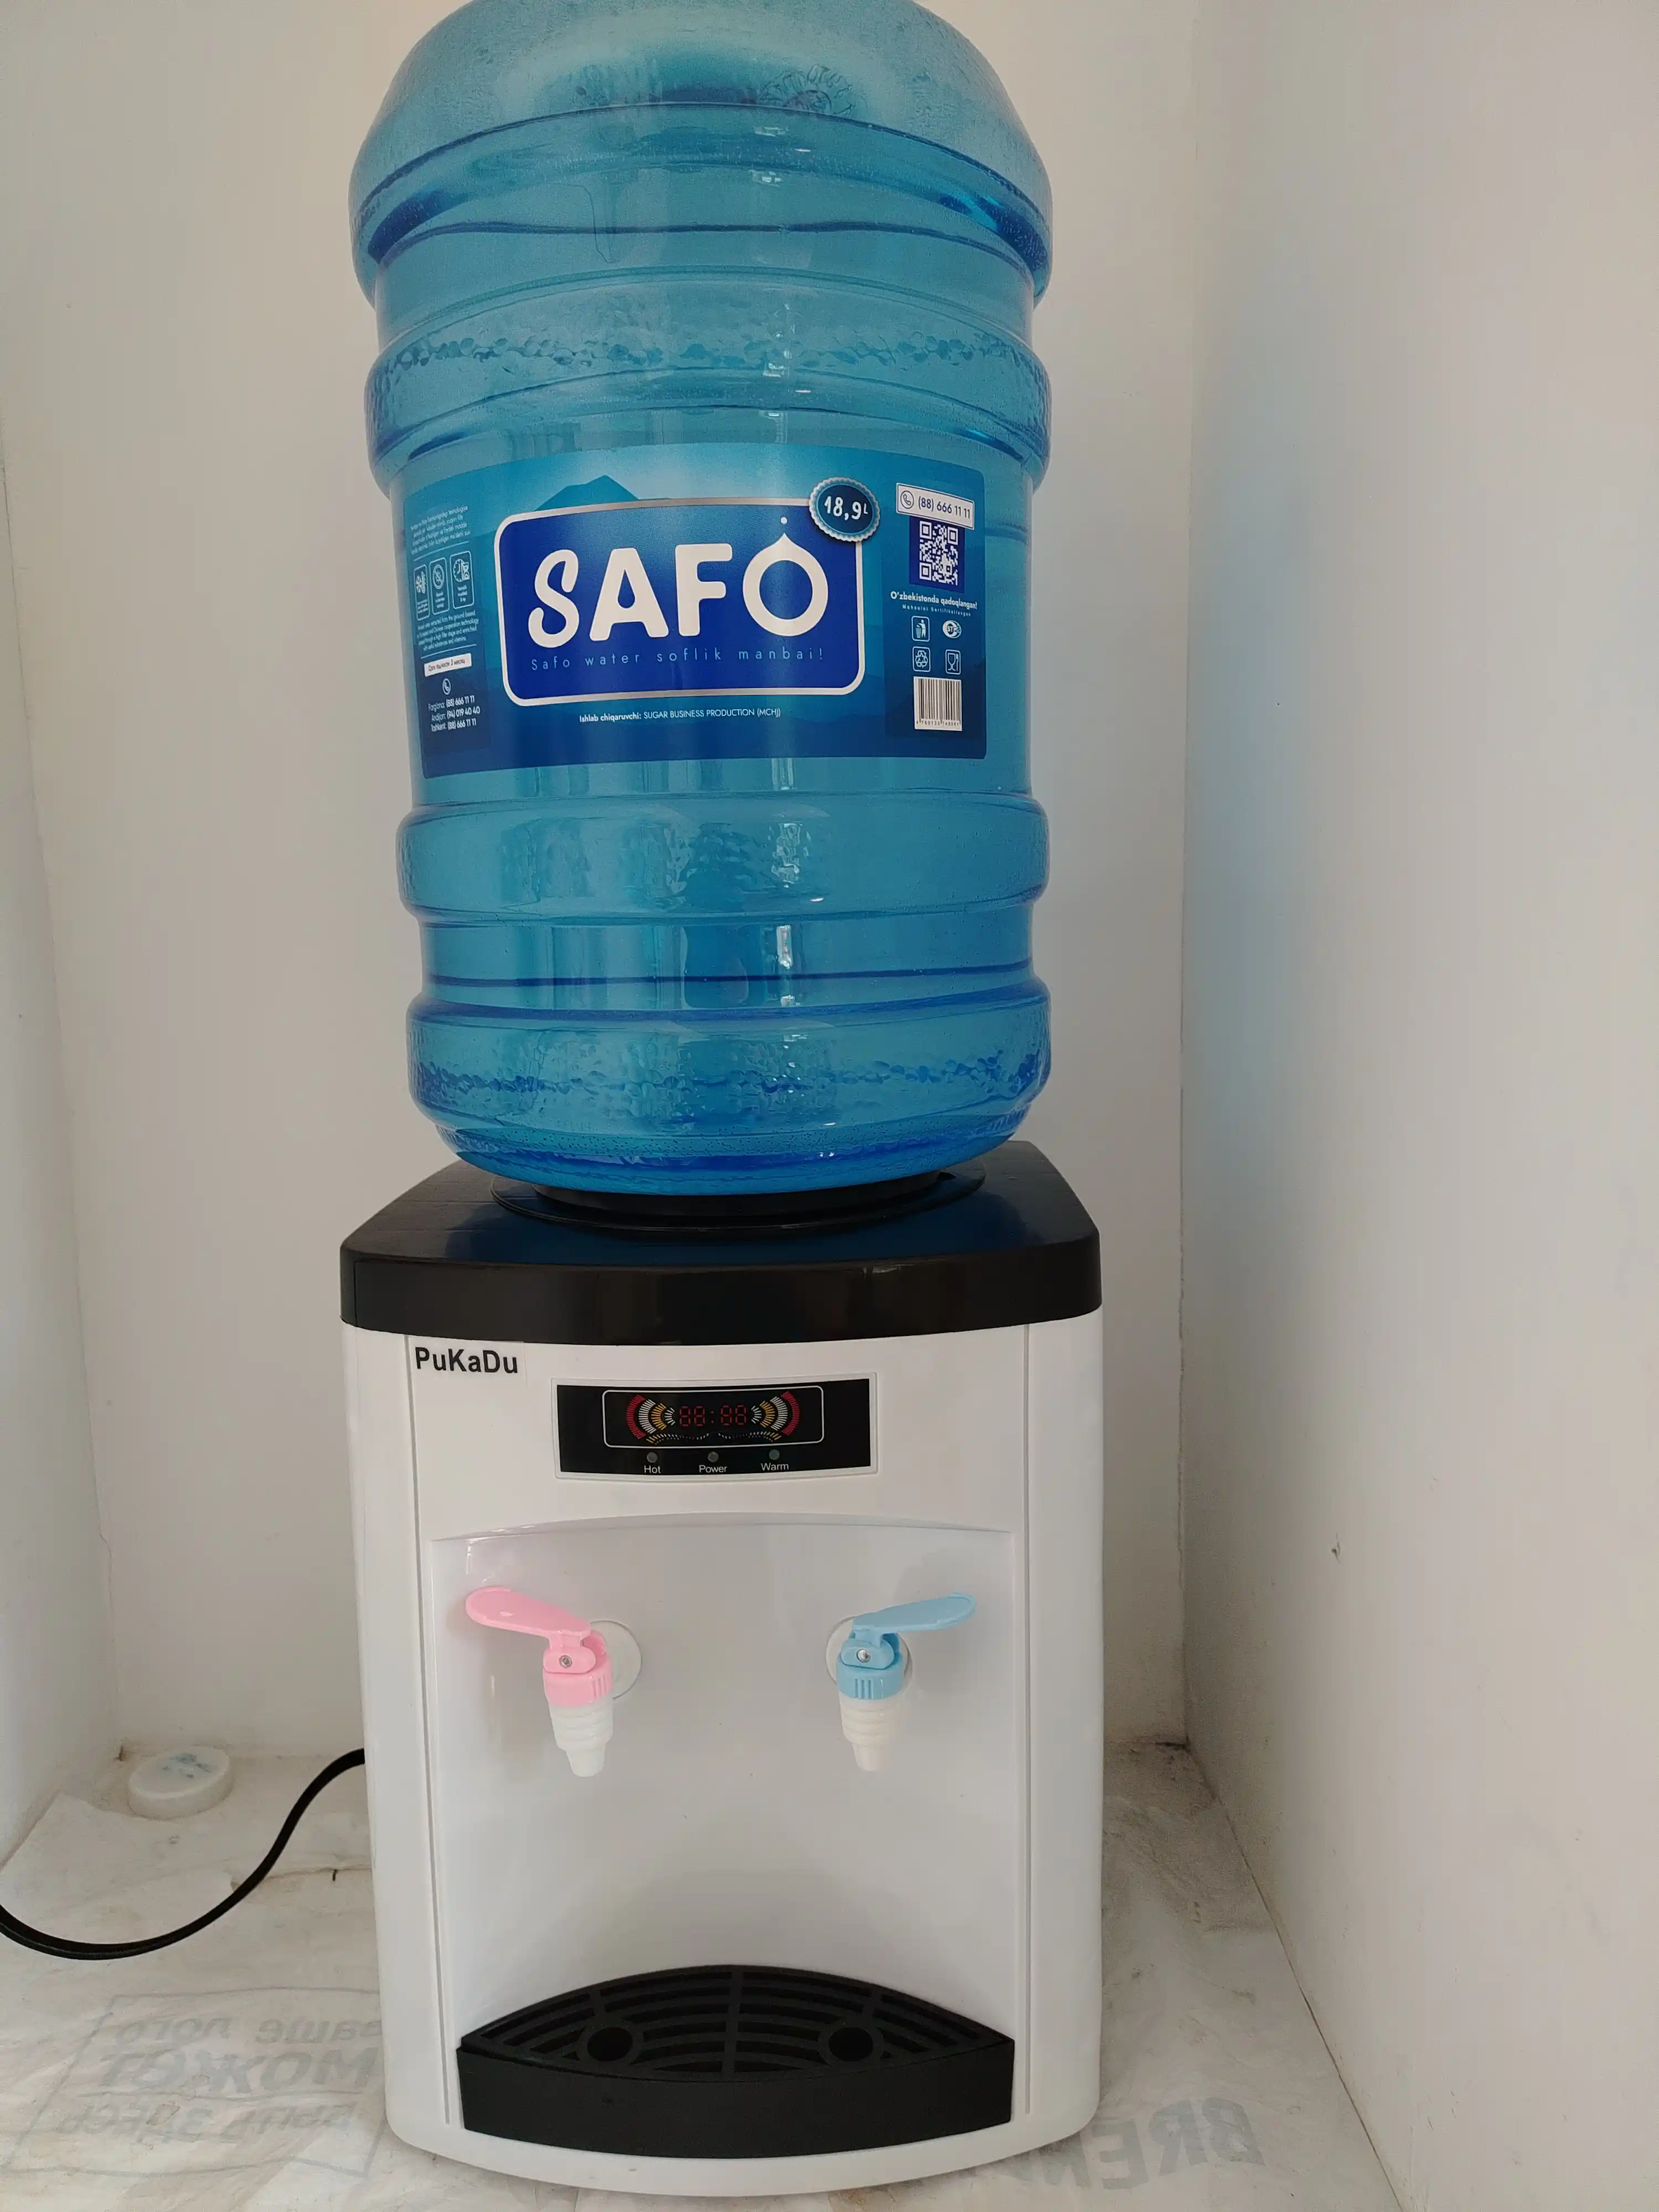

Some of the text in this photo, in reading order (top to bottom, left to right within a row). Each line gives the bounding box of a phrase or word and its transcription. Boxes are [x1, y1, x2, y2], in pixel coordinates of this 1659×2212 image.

[918, 496, 971, 519] (88) 666 11 11
[528, 533, 828, 648] SAFO
[890, 591, 977, 610] O'zbekistonda qadoqlangan!
[531, 646, 823, 671] Safo water soflik manbai!
[455, 697, 464, 706] 666
[456, 708, 464, 717] 019
[473, 706, 481, 714] 40
[600, 712, 641, 723] chiqaruvchi:
[643, 711, 668, 719] SUGAR
[670, 709, 704, 718] BUSINESS
[706, 708, 755, 717] PRODUCTION
[757, 708, 781, 718] (MCHJ)
[457, 719, 466, 728] 666
[472, 718, 476, 726] 11
[415, 1347, 518, 1374] PuKaDu
[644, 1465, 661, 1474] Hot
[699, 1464, 728, 1474] Power
[760, 1462, 790, 1472] Warm
